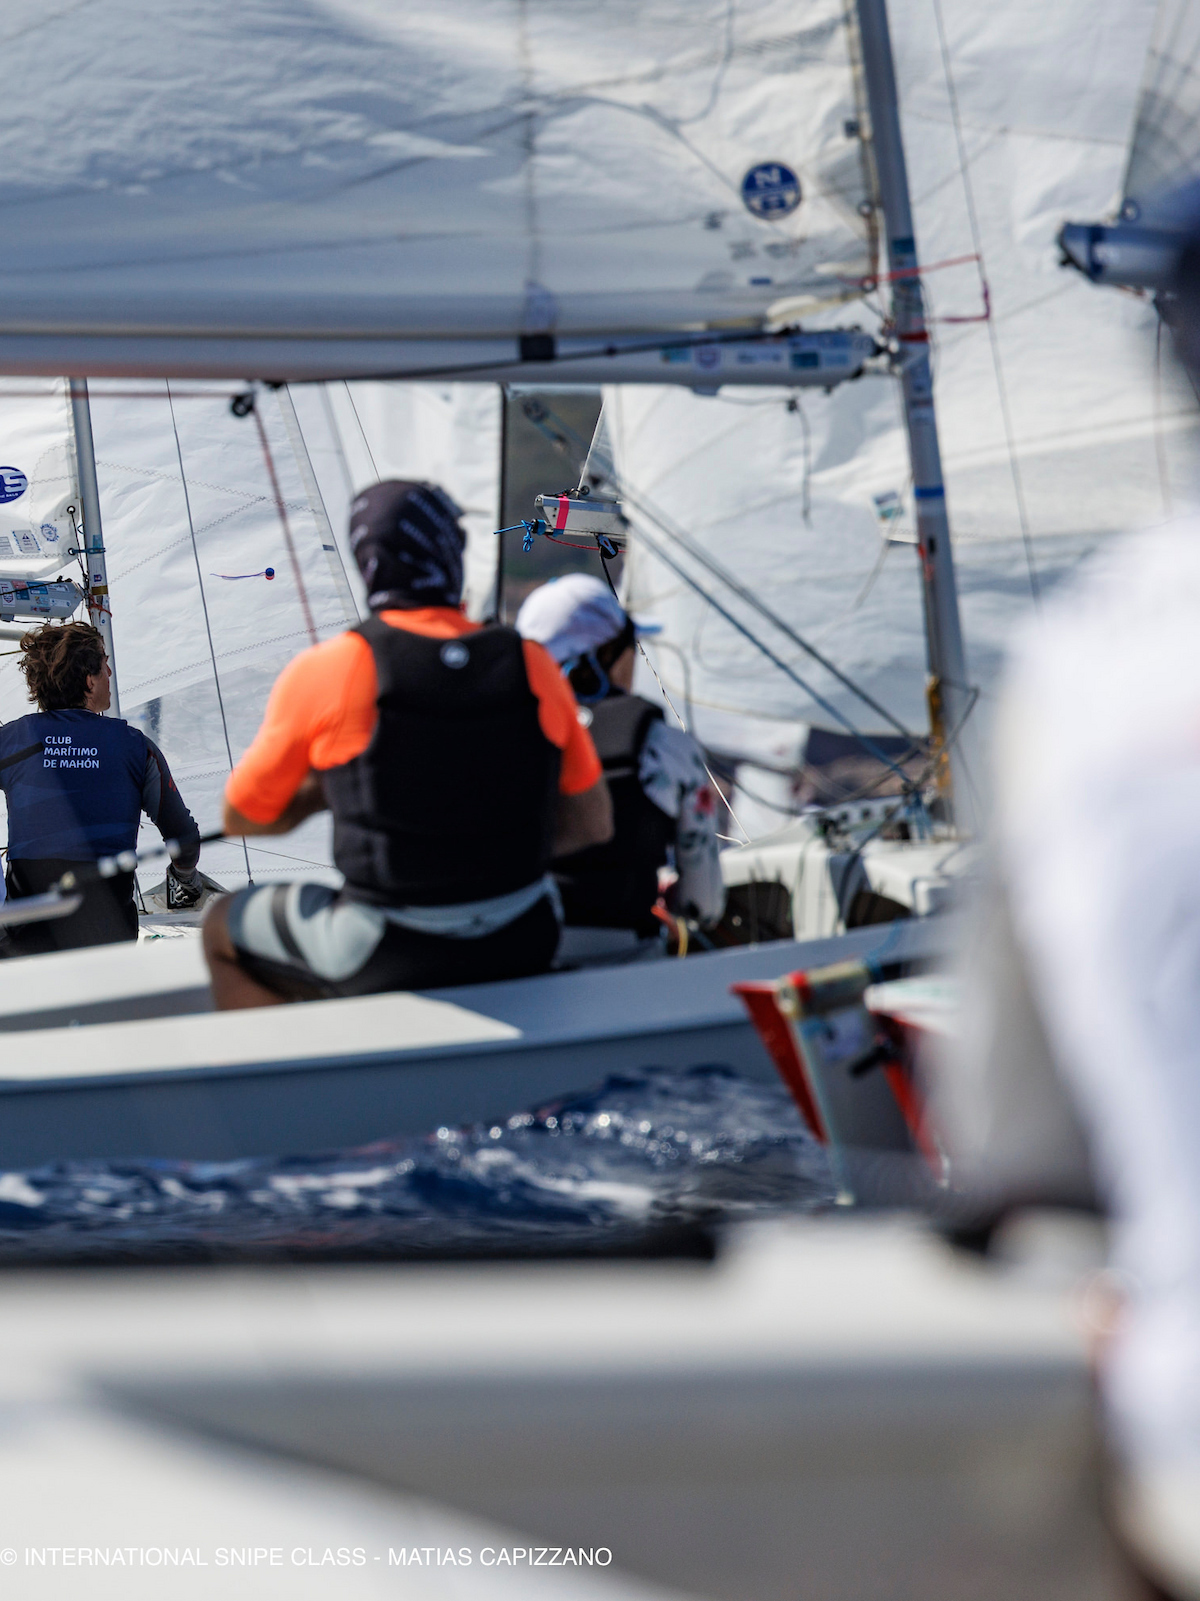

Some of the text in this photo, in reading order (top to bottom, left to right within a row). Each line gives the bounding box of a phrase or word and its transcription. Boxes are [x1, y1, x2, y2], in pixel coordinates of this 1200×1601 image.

[45, 735, 72, 744] CLUB
[44, 745, 98, 756] MARÍTIMO
[43, 757, 100, 769] DE MAHÓN
